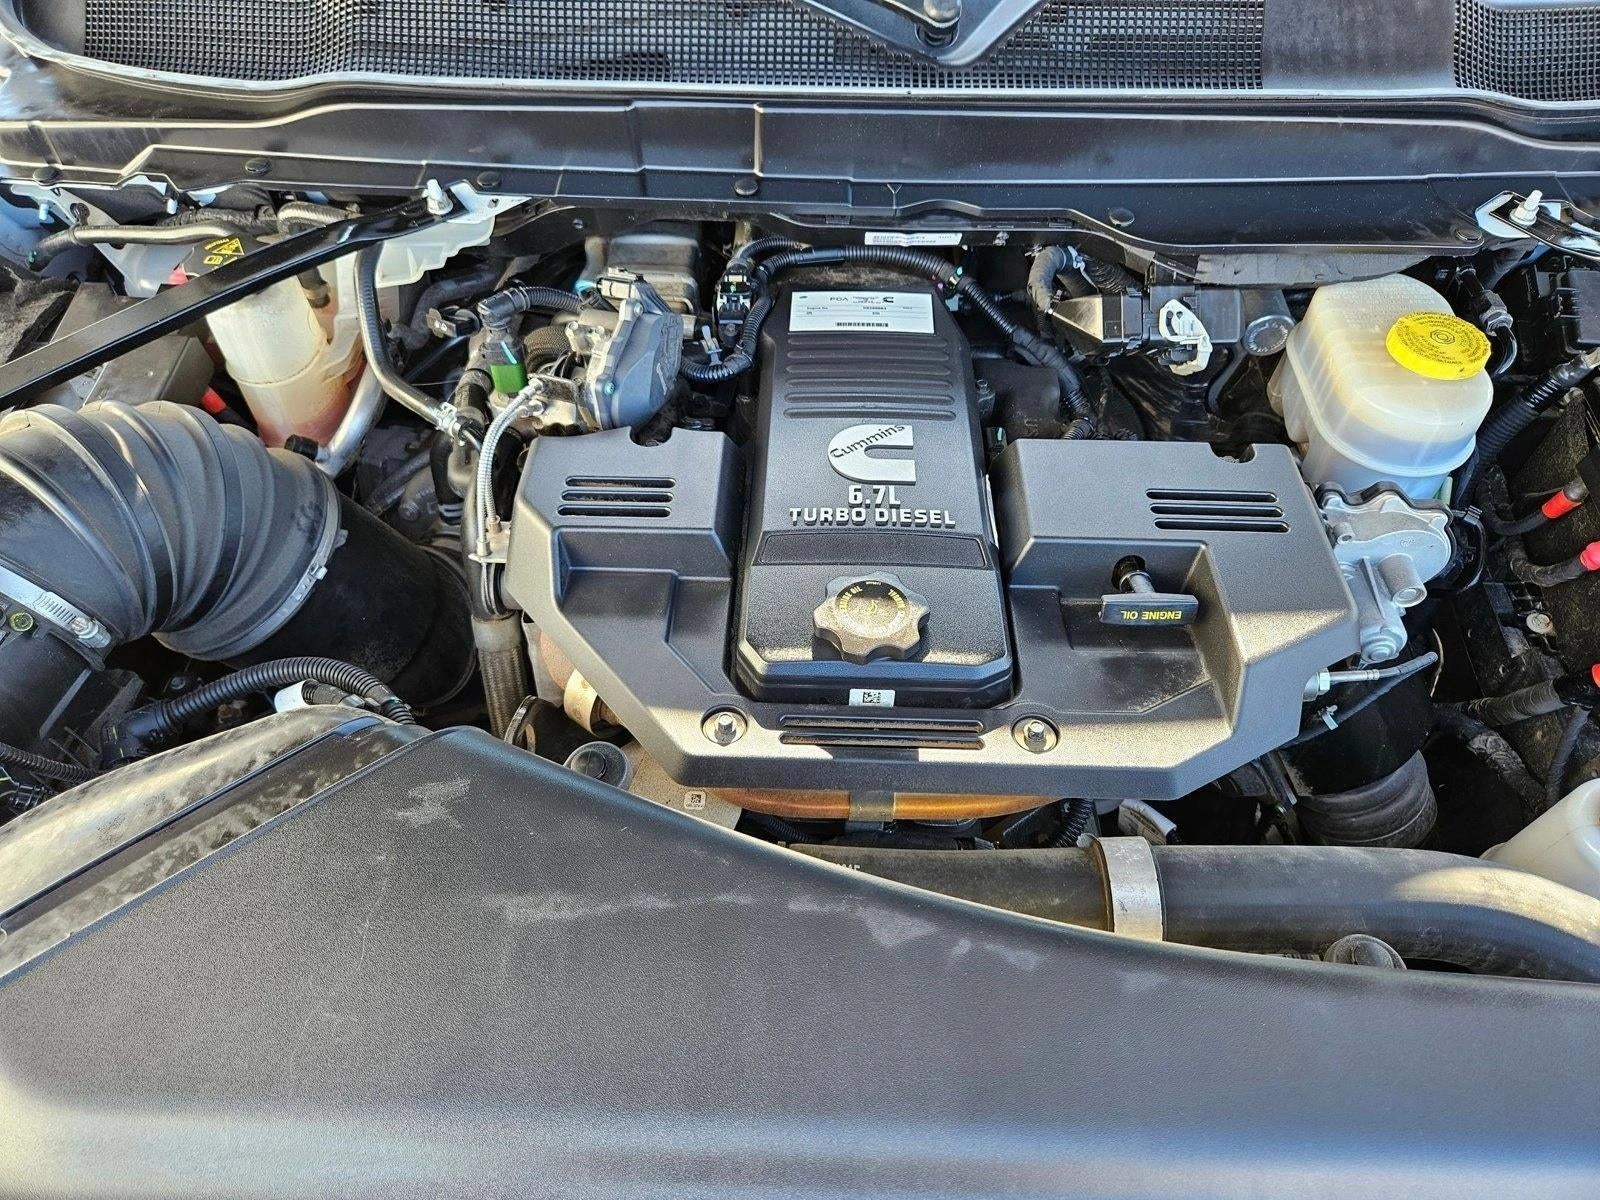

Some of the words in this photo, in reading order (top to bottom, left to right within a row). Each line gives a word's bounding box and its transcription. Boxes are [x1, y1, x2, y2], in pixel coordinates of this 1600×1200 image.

[829, 424, 905, 458] Cummins
[848, 485, 901, 508] 6.7L
[789, 507, 867, 526] TURBO
[875, 508, 956, 529] DIESEL
[1120, 610, 1138, 620] OIL
[1141, 610, 1182, 620] ENGINE
